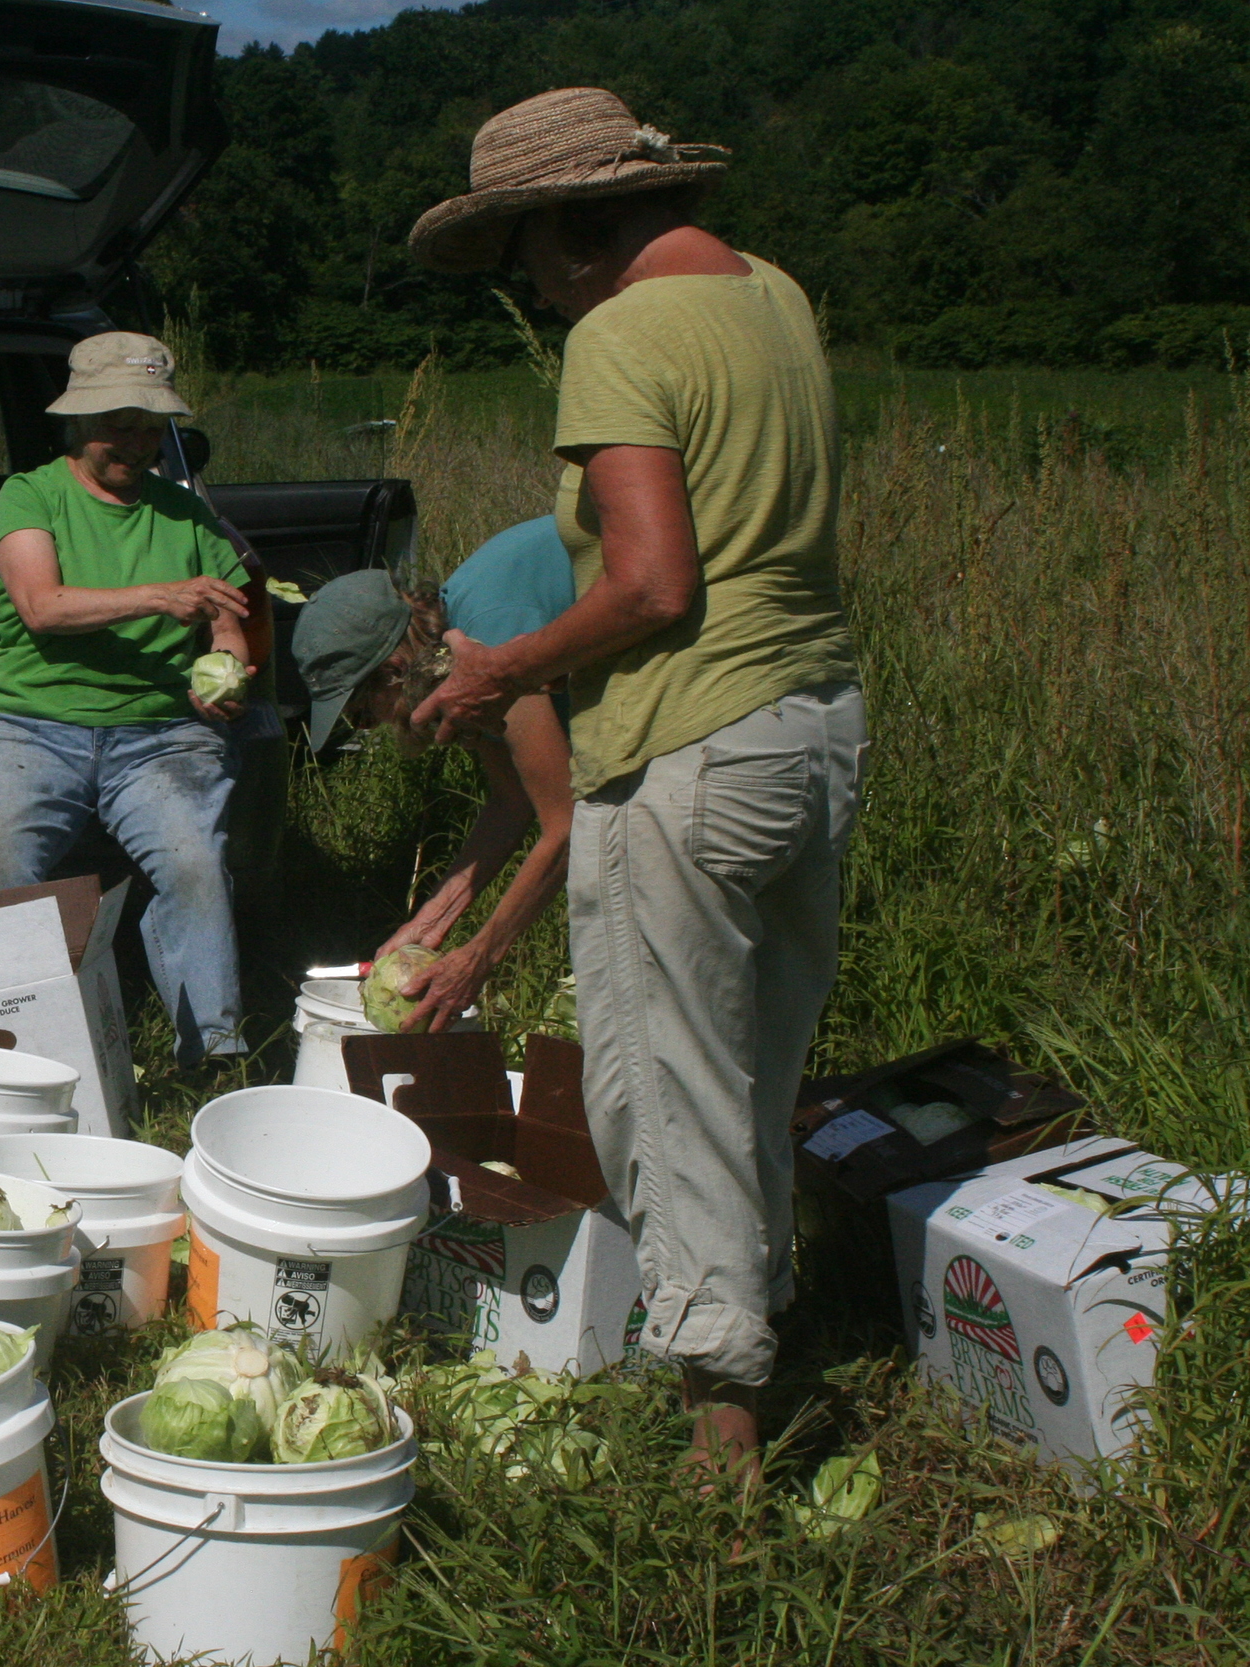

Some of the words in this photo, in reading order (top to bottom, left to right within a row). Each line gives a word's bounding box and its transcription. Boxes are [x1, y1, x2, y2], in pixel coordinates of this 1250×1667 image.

[0, 993, 37, 1007] GROWER
[85, 1261, 120, 1269] WARNING
[287, 1261, 326, 1271] WARNING
[88, 1271, 111, 1280] AVISO
[290, 1271, 316, 1281] AVISO
[402, 1276, 501, 1343] FARMS
[949, 1333, 1026, 1393] BRYSON
[953, 1360, 1035, 1429] FARMS
